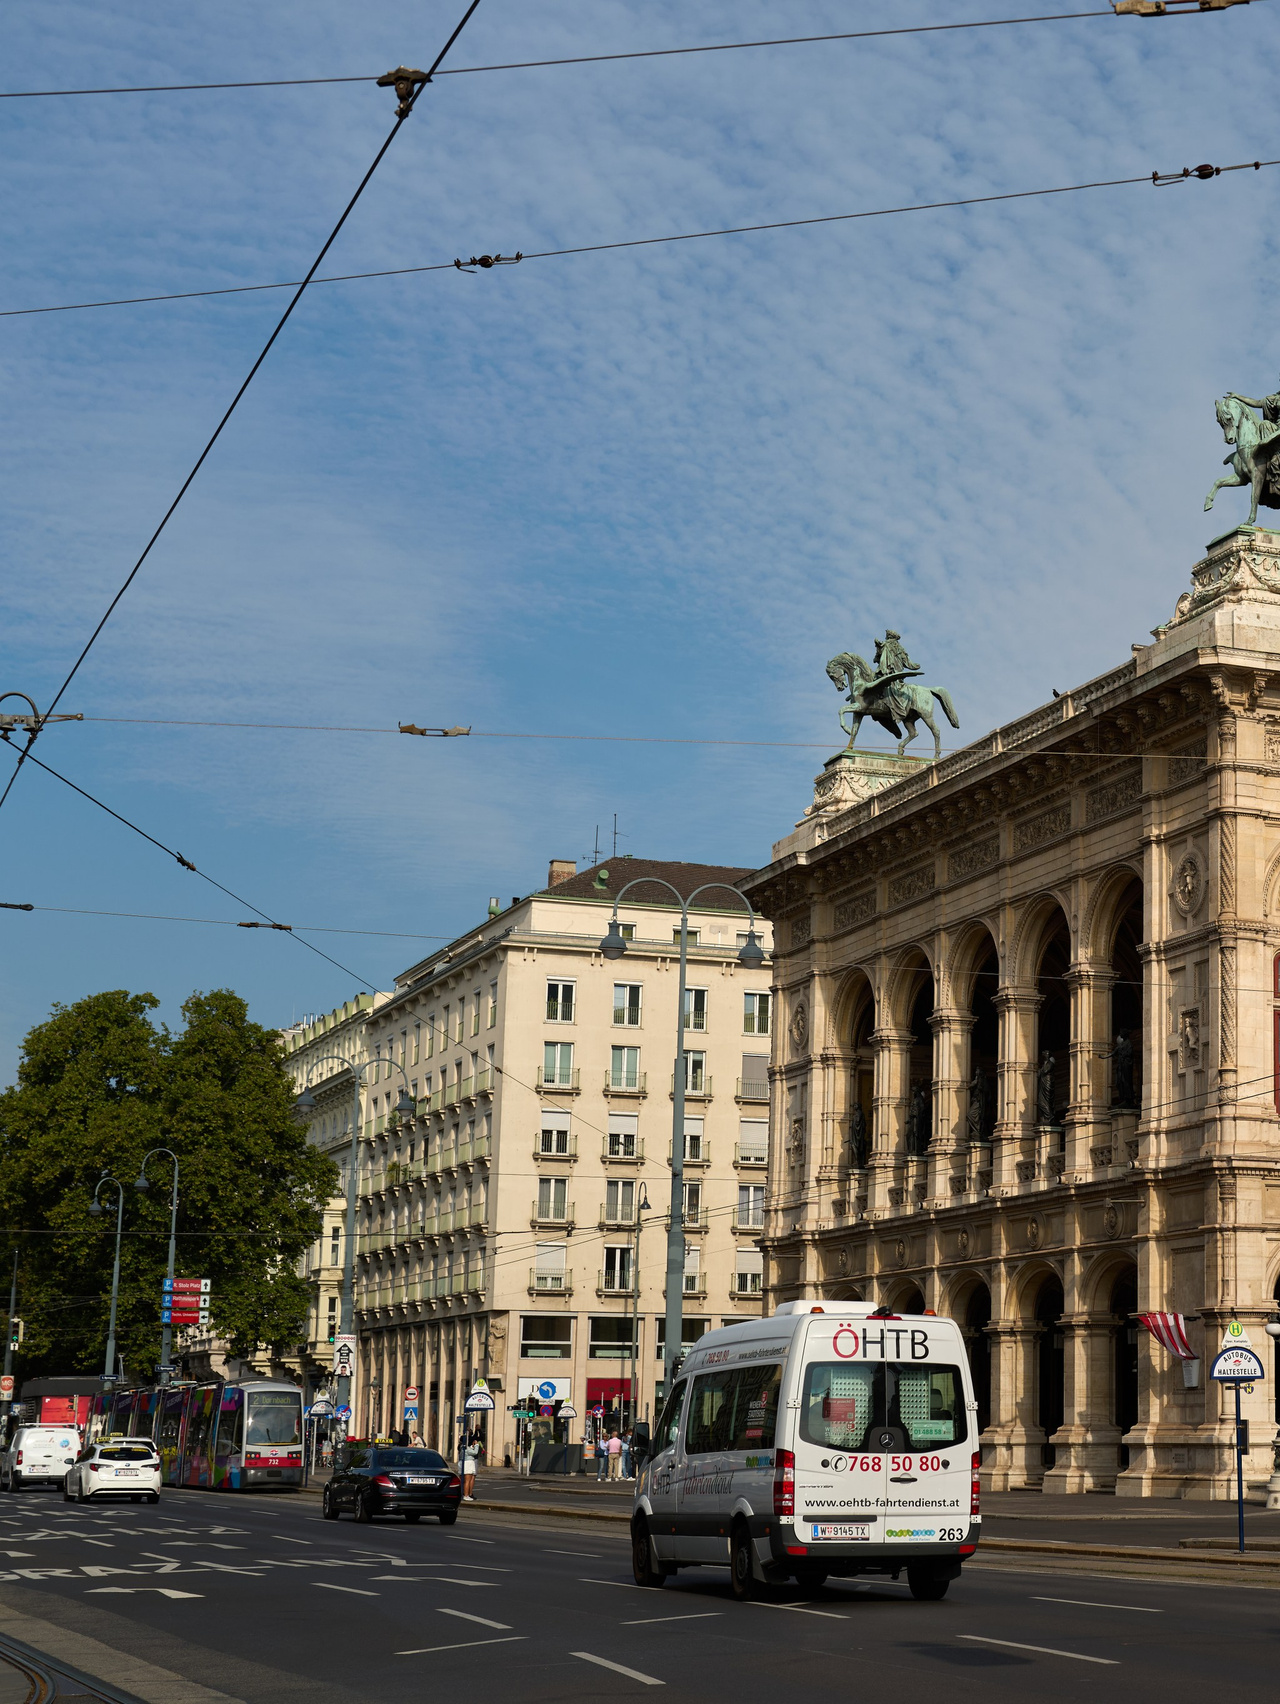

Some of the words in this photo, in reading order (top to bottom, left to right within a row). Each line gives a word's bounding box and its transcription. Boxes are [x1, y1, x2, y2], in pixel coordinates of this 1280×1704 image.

[833, 1323, 929, 1359] ÖHTB
[1223, 1351, 1253, 1363] AUTOBUS
[253, 1395, 259, 1404] 2
[262, 1396, 291, 1404] Dornbach
[848, 1456, 882, 1472] 768
[891, 1456, 912, 1472] 50
[919, 1456, 940, 1472] 80
[804, 1497, 960, 1508] www.oehtb-fahrtendienst.at
[833, 1526, 854, 1536] 9145
[855, 1526, 866, 1536] TX
[939, 1528, 964, 1542] 263
